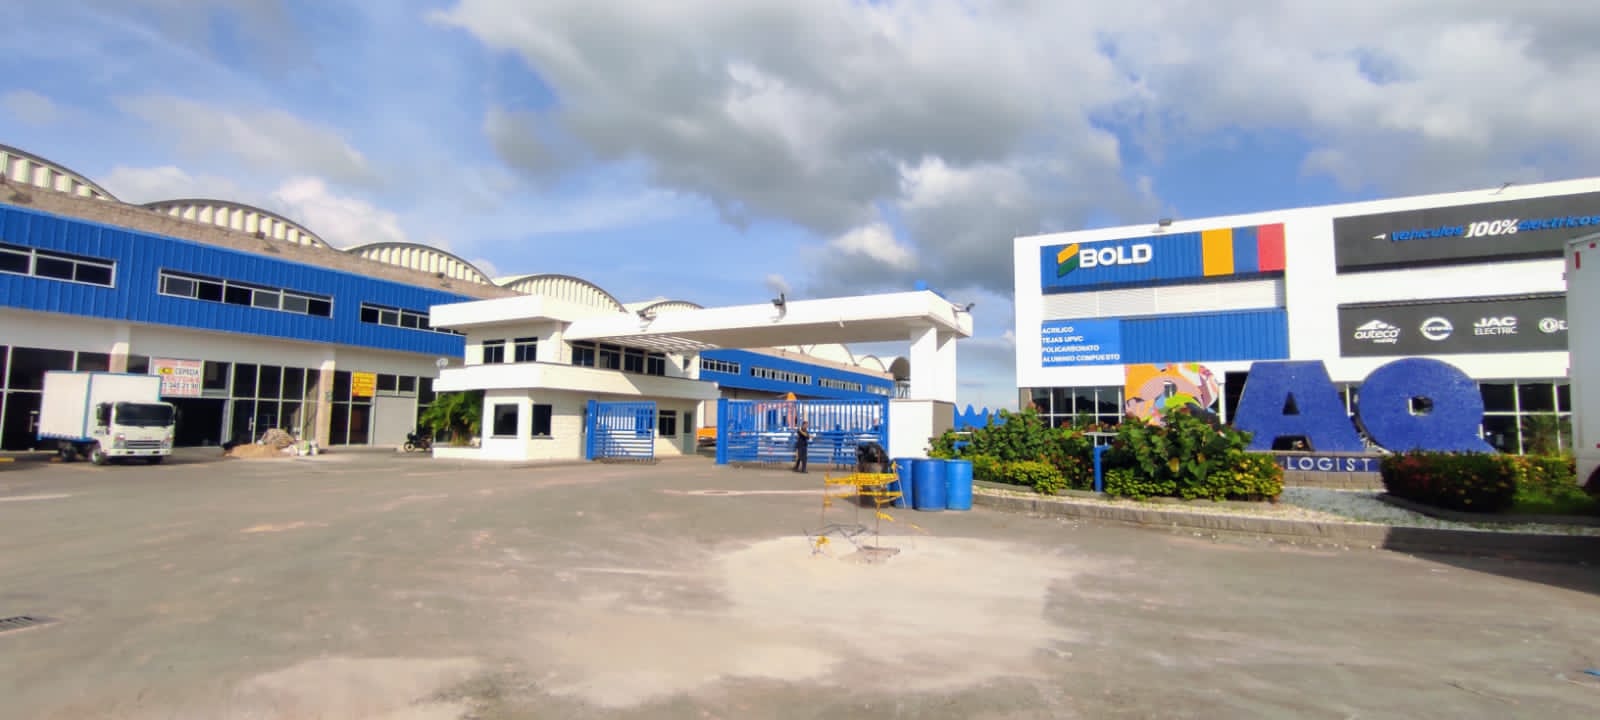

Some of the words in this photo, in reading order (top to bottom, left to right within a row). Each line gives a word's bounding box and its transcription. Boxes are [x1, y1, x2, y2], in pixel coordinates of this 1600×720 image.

[1464, 218, 1520, 239] 100%
[1080, 243, 1152, 268] BOLD
[1473, 316, 1518, 328] JAC
[1042, 326, 1074, 334] ACRILICO
[1354, 327, 1400, 339] auteco
[1474, 326, 1518, 336] ELECTRIC
[1042, 336, 1063, 344] TEJAS
[1064, 335, 1084, 343] UPVC
[1042, 344, 1100, 353] POLICARBONATO
[1043, 355, 1076, 363] ALUMINIO
[1076, 353, 1120, 361] COMPUESTO
[1233, 358, 1501, 453] AQ
